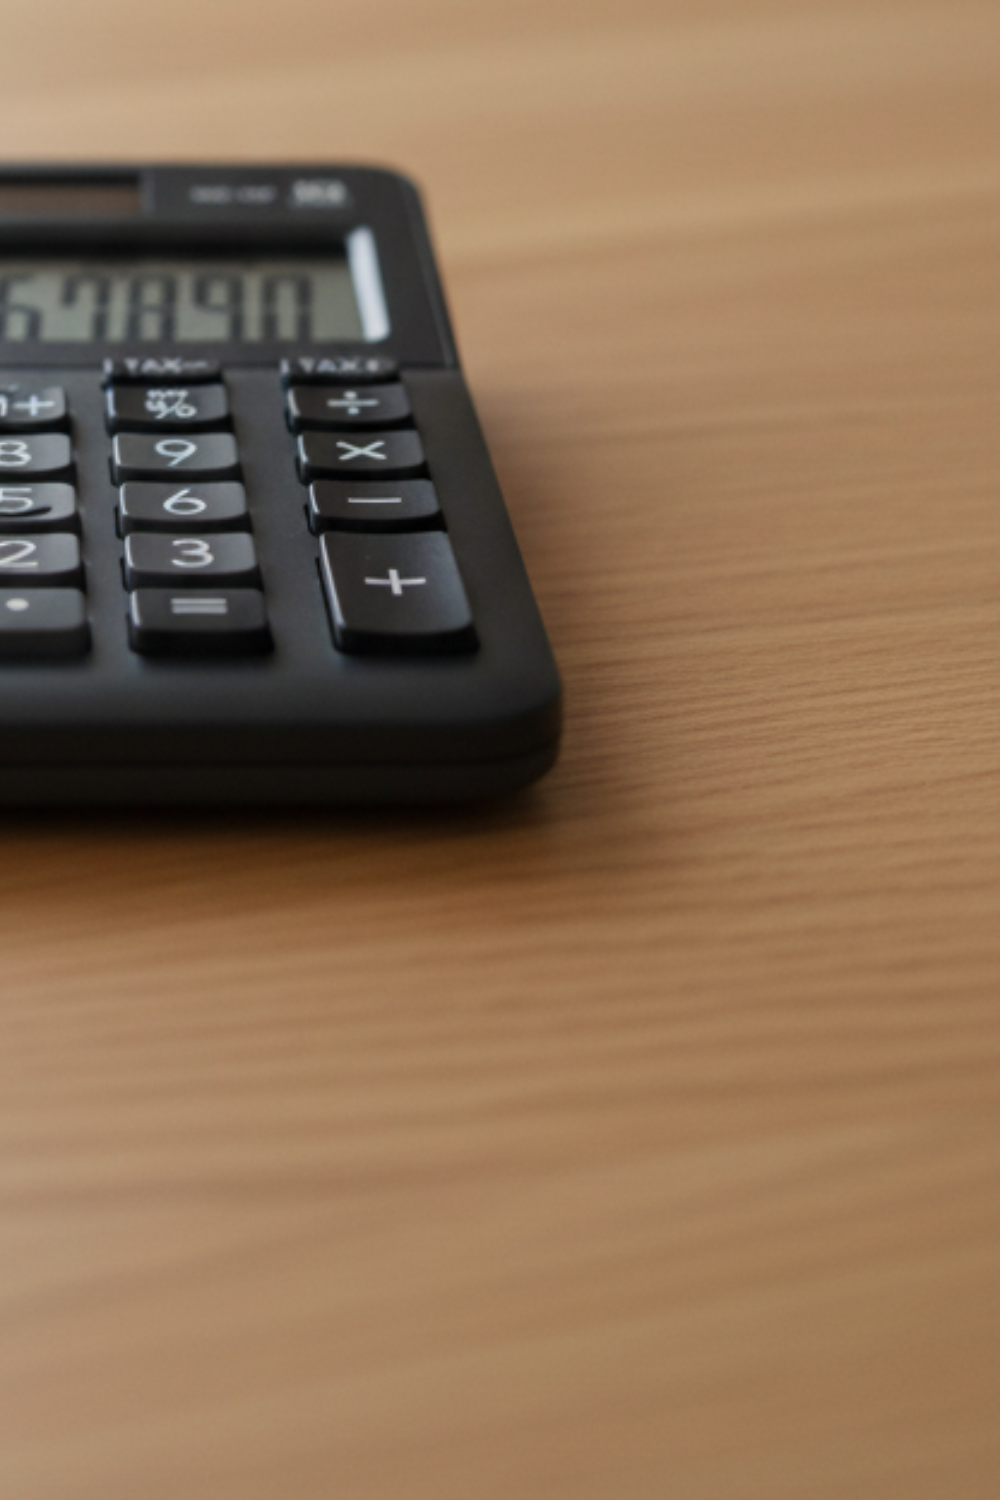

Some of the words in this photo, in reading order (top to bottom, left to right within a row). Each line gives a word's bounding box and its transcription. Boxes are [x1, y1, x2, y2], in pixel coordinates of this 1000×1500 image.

[155, 439, 198, 467] 9
[162, 487, 207, 516] 6
[170, 538, 215, 568] 3
